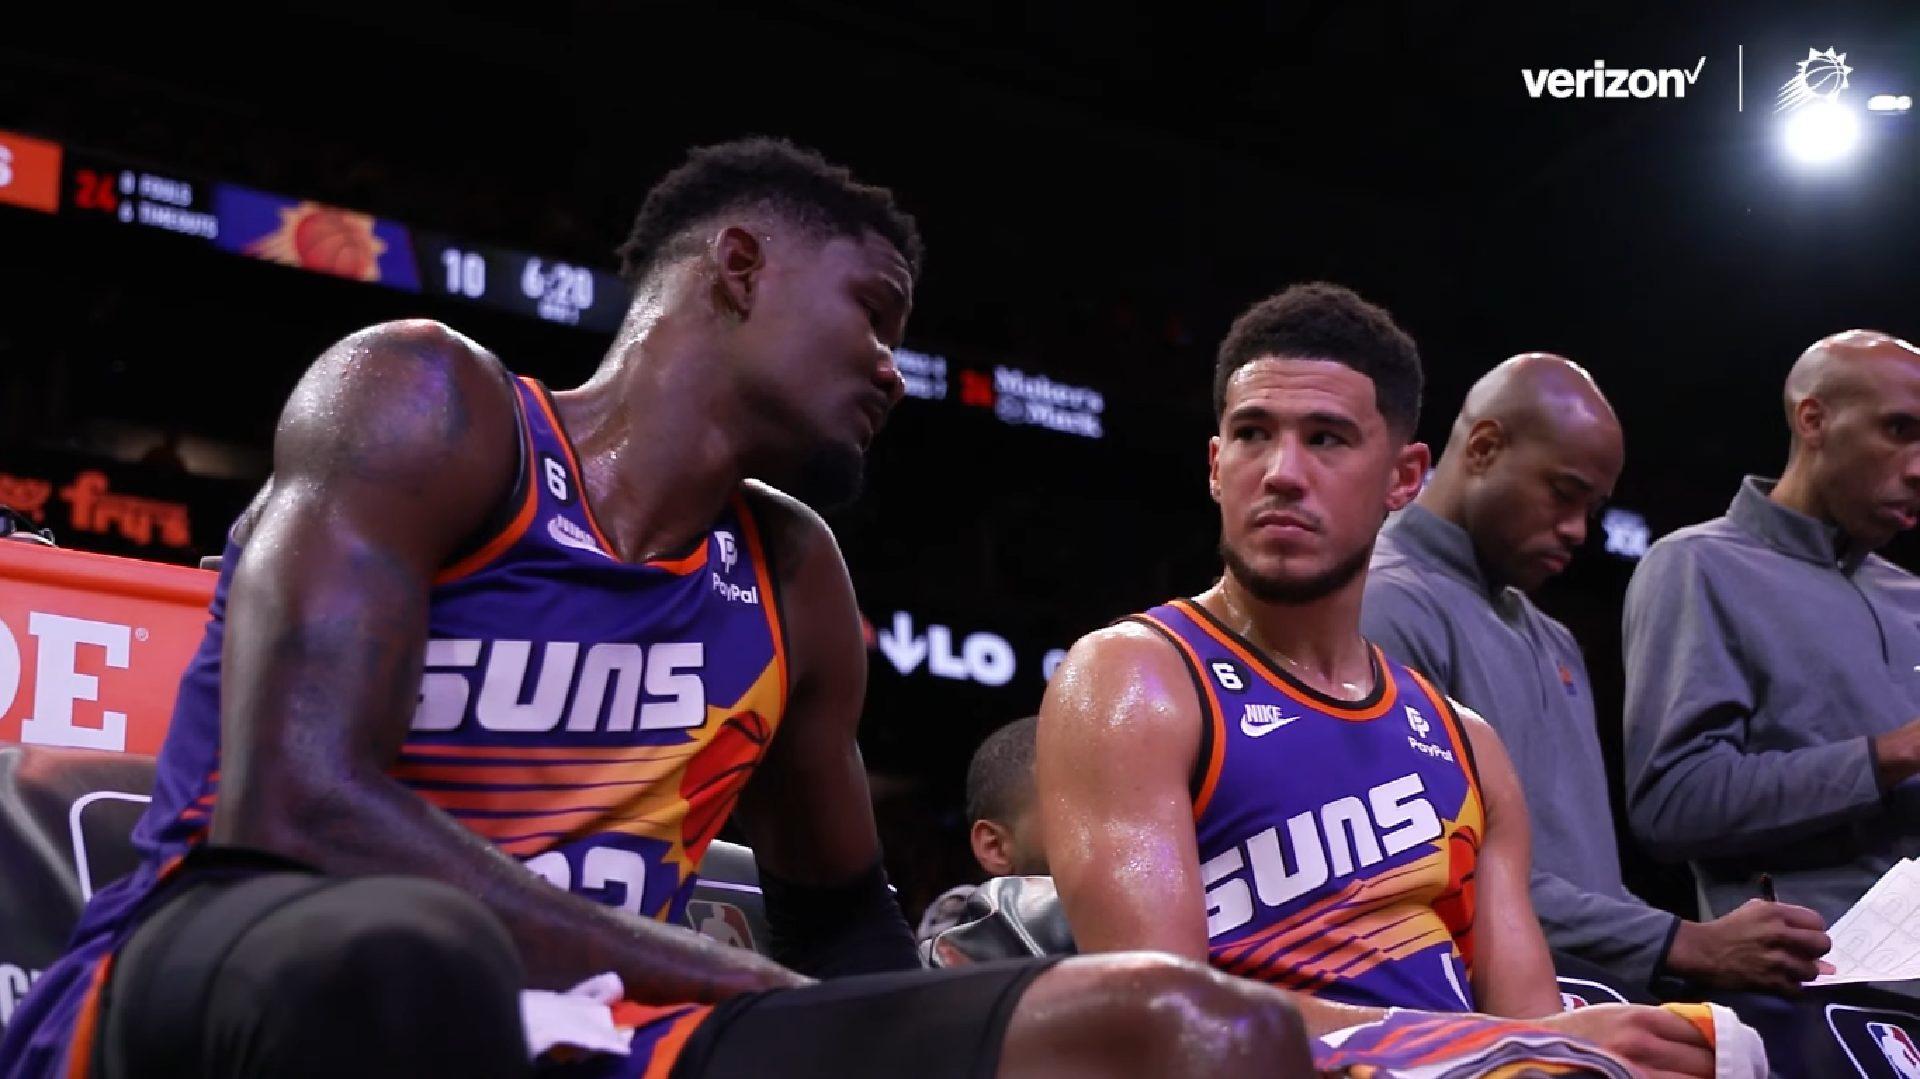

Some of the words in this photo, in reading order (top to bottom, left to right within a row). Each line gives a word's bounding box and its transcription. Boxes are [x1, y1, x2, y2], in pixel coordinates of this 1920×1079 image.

[441, 249, 486, 299] 10
[521, 256, 594, 310] 6:20
[544, 457, 567, 500] 6
[712, 572, 759, 604] PayPal
[0, 610, 131, 752] E
[410, 638, 705, 732] SUNS
[1212, 662, 1244, 690] 6
[1244, 704, 1282, 723] NIKE
[1408, 735, 1454, 763] PayPal
[1201, 772, 1443, 939] SUNS
